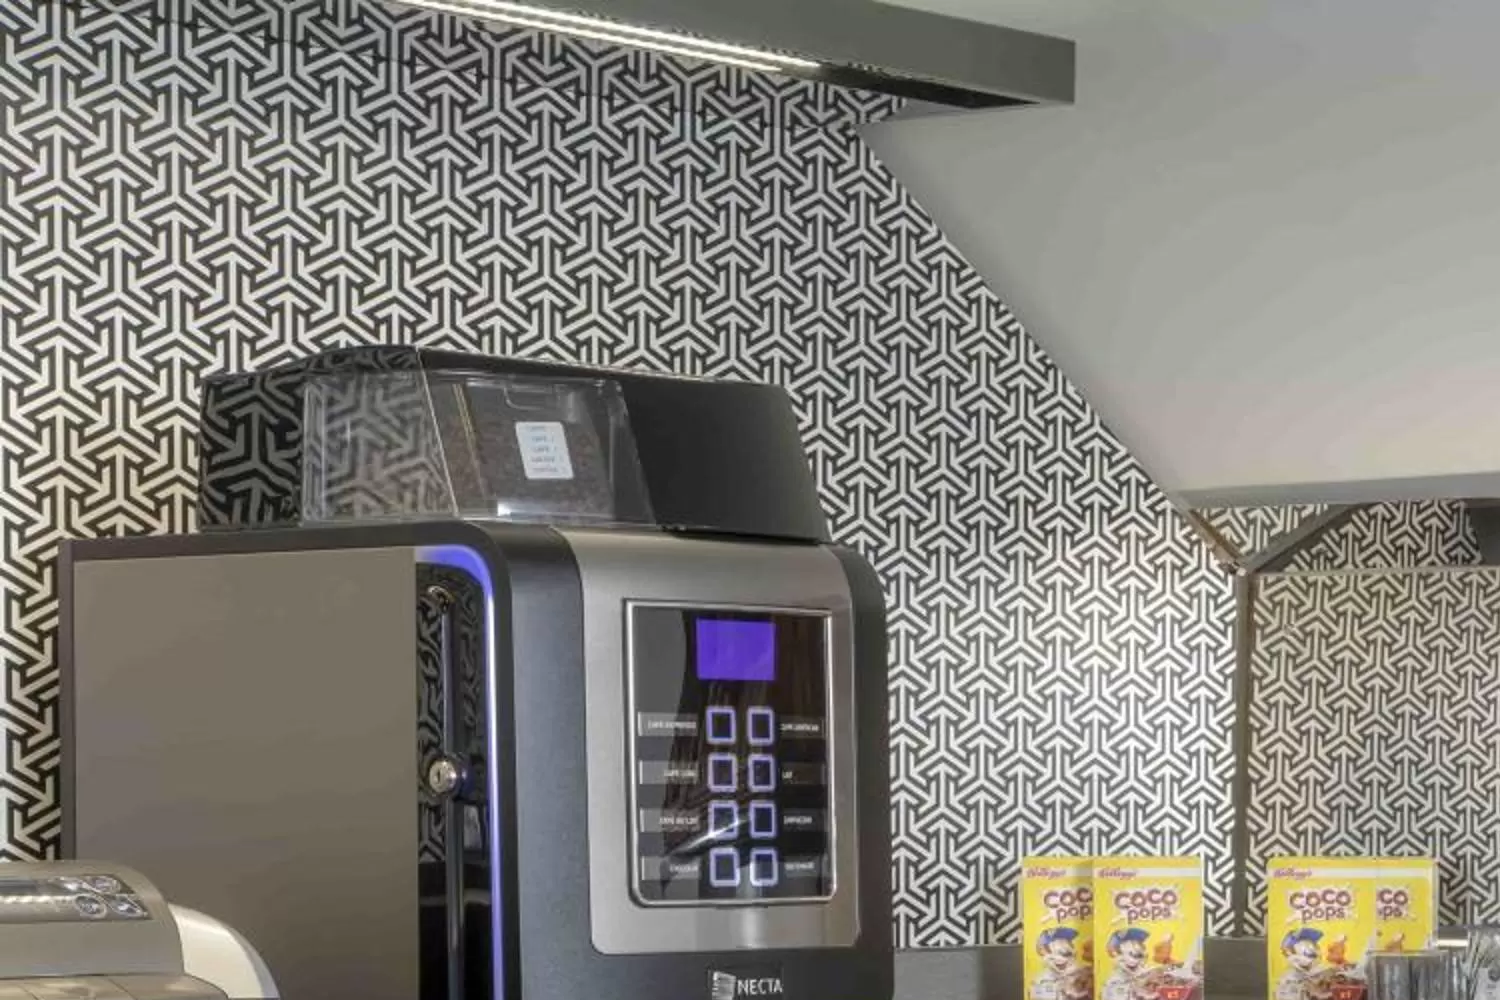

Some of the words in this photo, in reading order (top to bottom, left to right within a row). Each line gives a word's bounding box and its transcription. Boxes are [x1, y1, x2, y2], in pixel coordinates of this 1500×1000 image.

[1043, 887, 1093, 909] COC
[1378, 888, 1409, 905] CO
[1056, 904, 1093, 923] pop
[1127, 905, 1173, 923] pops
[1301, 906, 1346, 923] pops
[737, 978, 783, 996] NECTA
